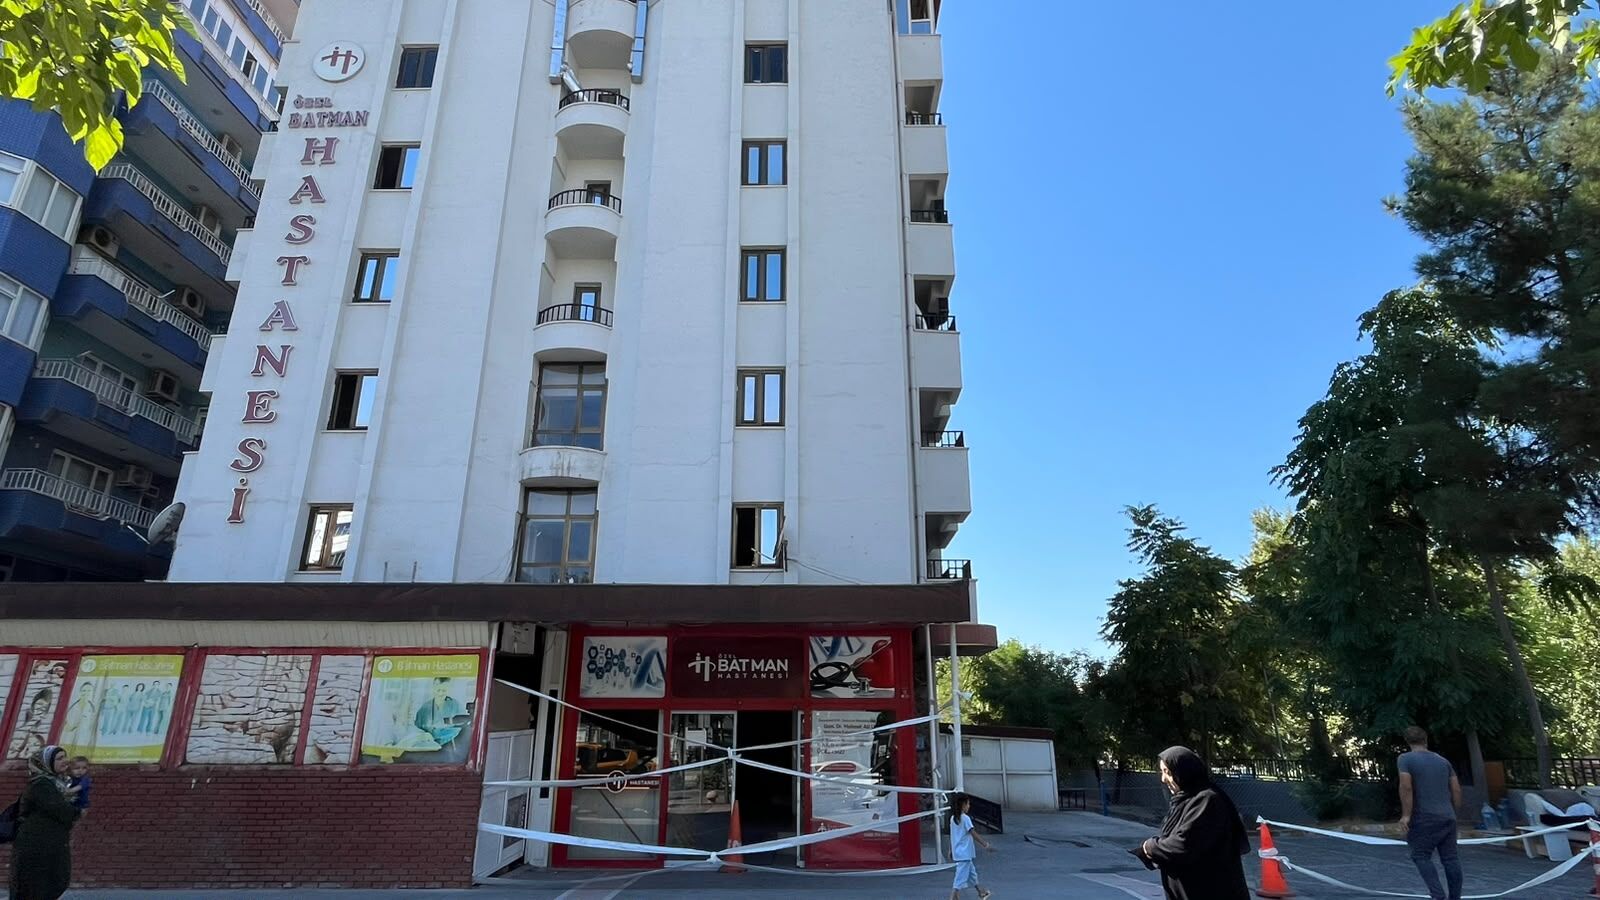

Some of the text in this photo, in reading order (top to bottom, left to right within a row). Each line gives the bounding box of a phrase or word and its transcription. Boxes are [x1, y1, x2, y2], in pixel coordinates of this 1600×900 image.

[288, 110, 369, 129] BATMAN
[227, 137, 340, 524] HASTANESİ
[397, 660, 431, 671] Batman
[718, 659, 788, 672] BATMAN
[717, 671, 789, 680] HASTANESİ
